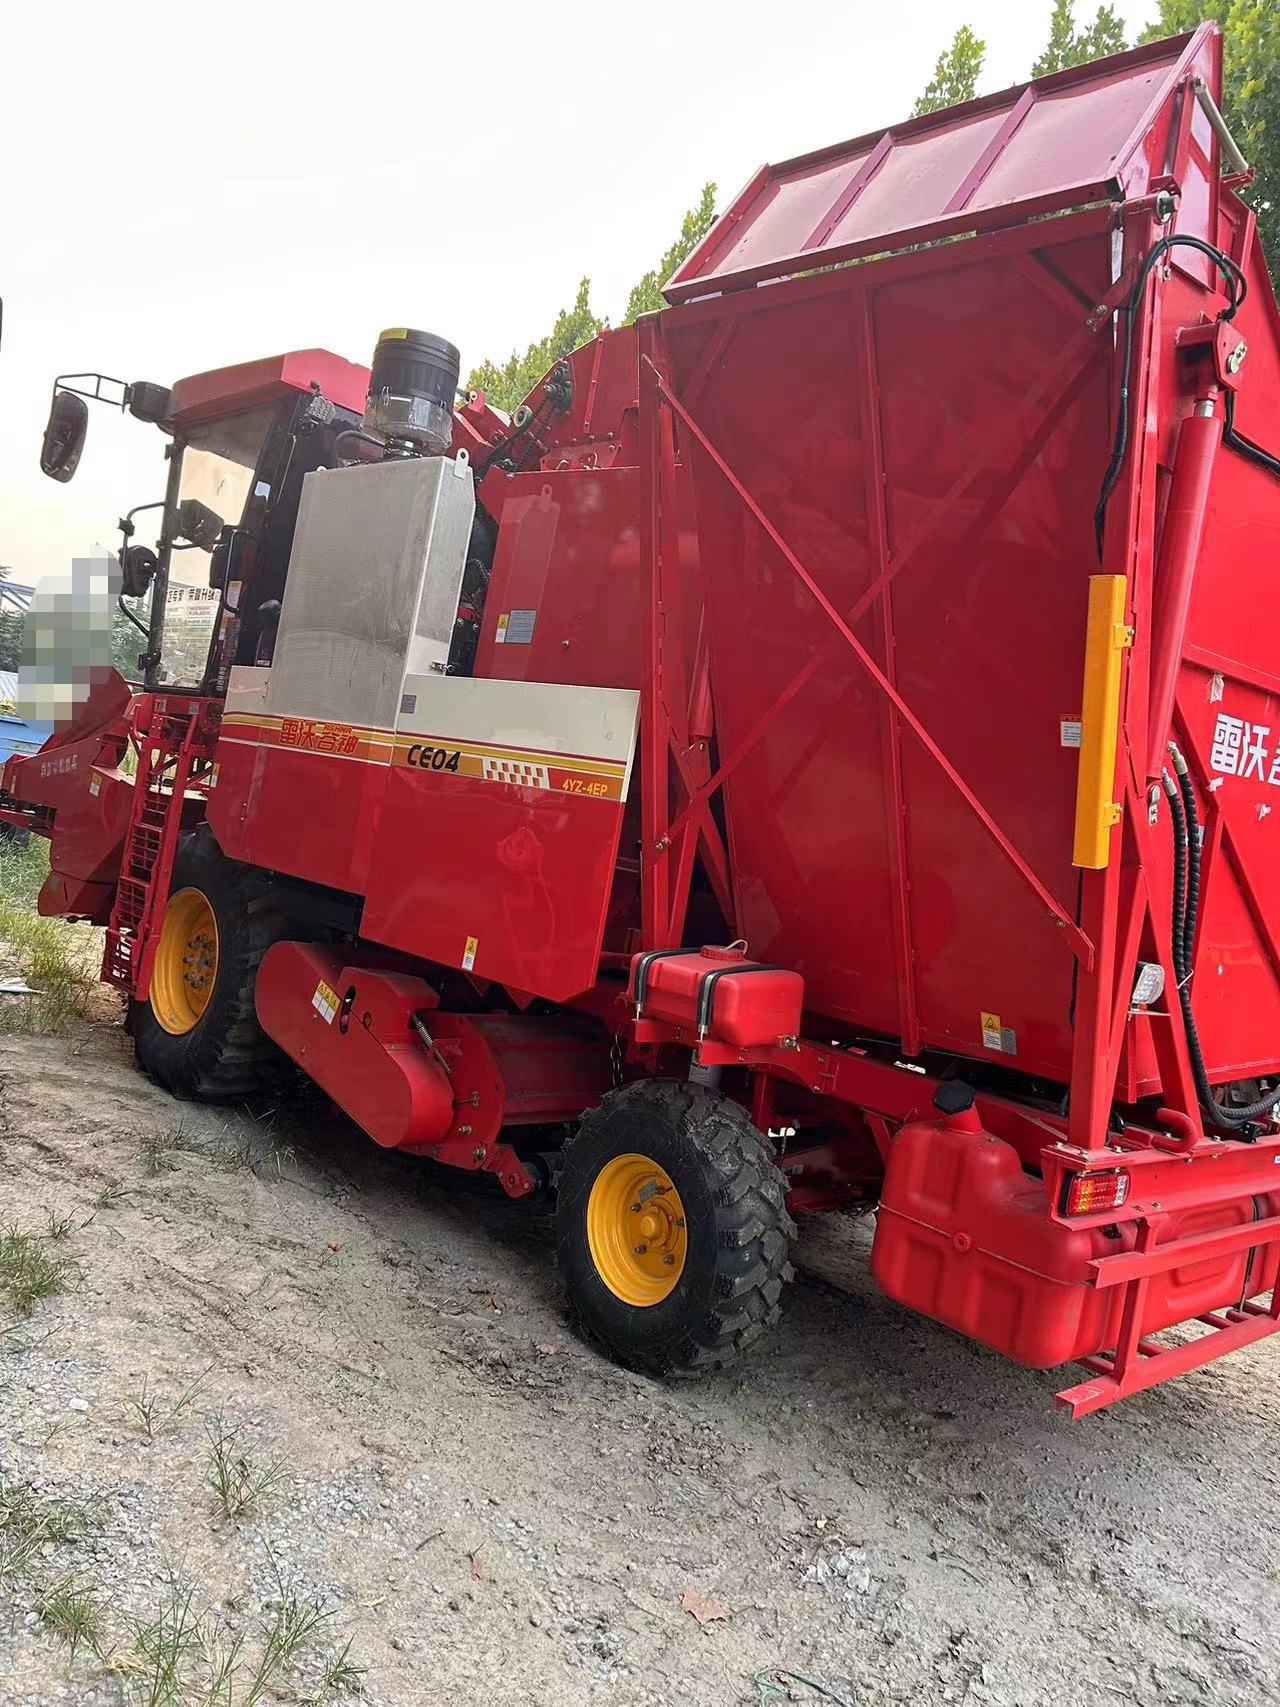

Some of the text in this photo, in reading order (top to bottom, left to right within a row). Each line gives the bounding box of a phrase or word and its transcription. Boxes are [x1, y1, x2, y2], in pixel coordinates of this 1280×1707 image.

[280, 718, 359, 754] 雷沃谷神
[562, 778, 608, 796] 4YZ-4EP
